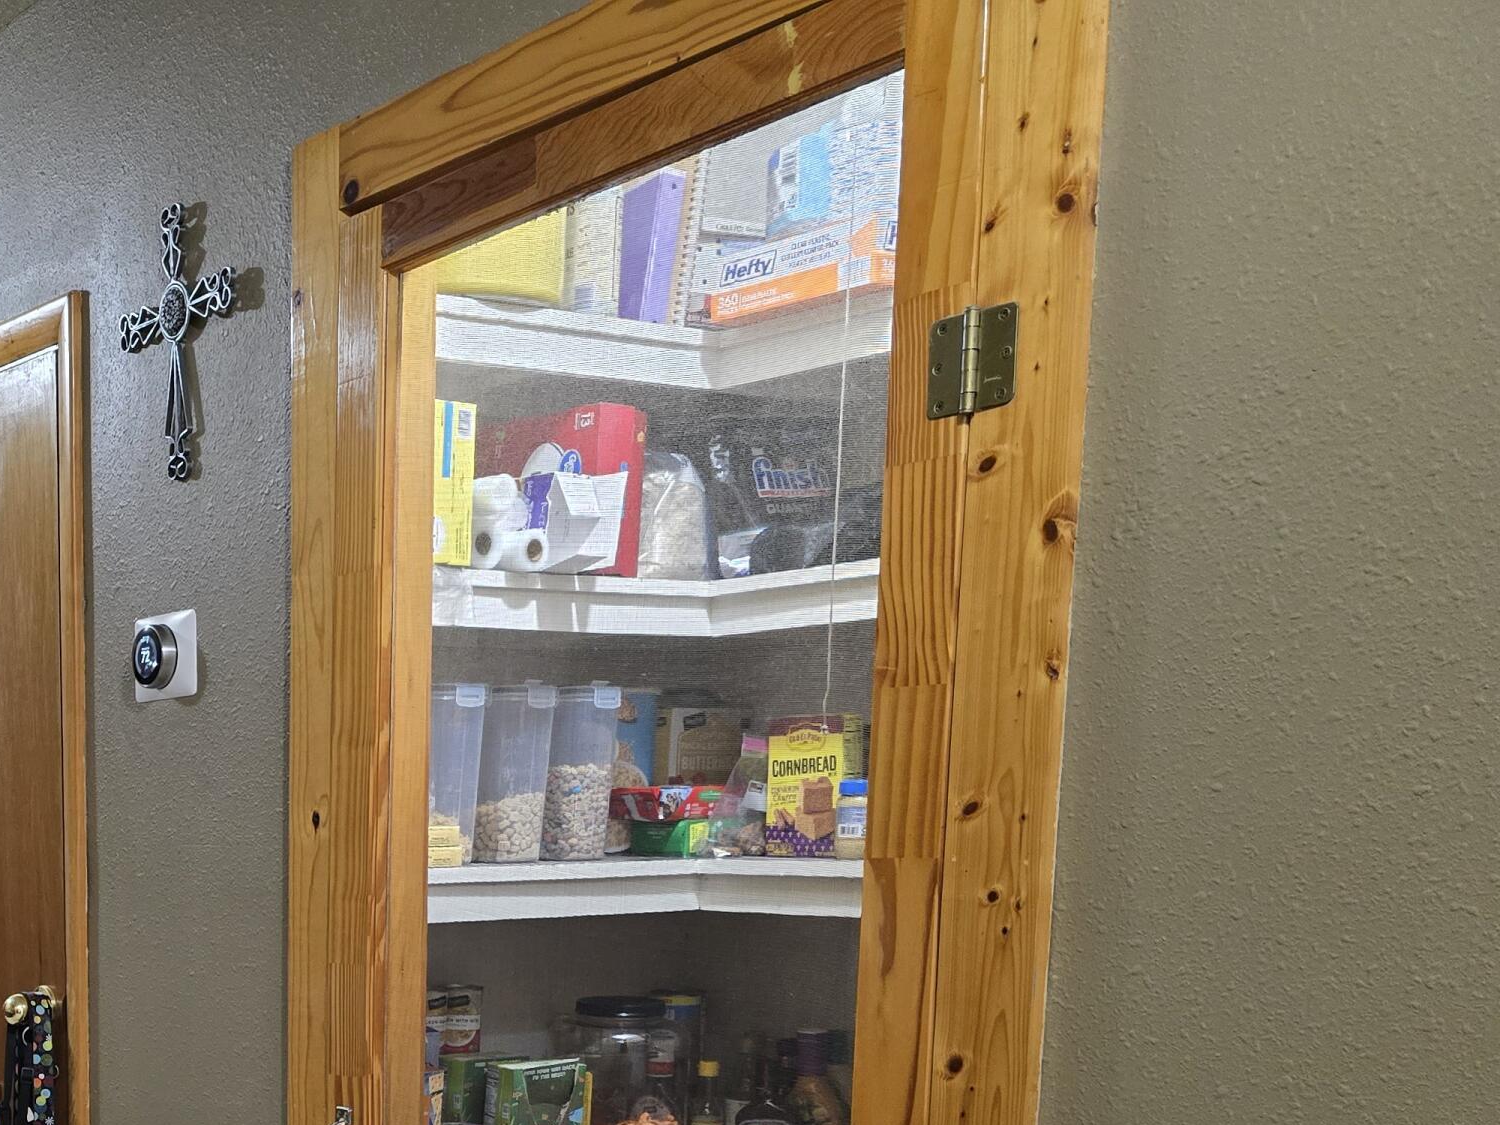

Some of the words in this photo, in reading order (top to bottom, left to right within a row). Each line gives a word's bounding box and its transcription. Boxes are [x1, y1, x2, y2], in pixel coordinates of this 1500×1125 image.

[724, 256, 772, 282] Hefty
[752, 456, 830, 490] finish
[772, 755, 837, 777] CORNBREAD
